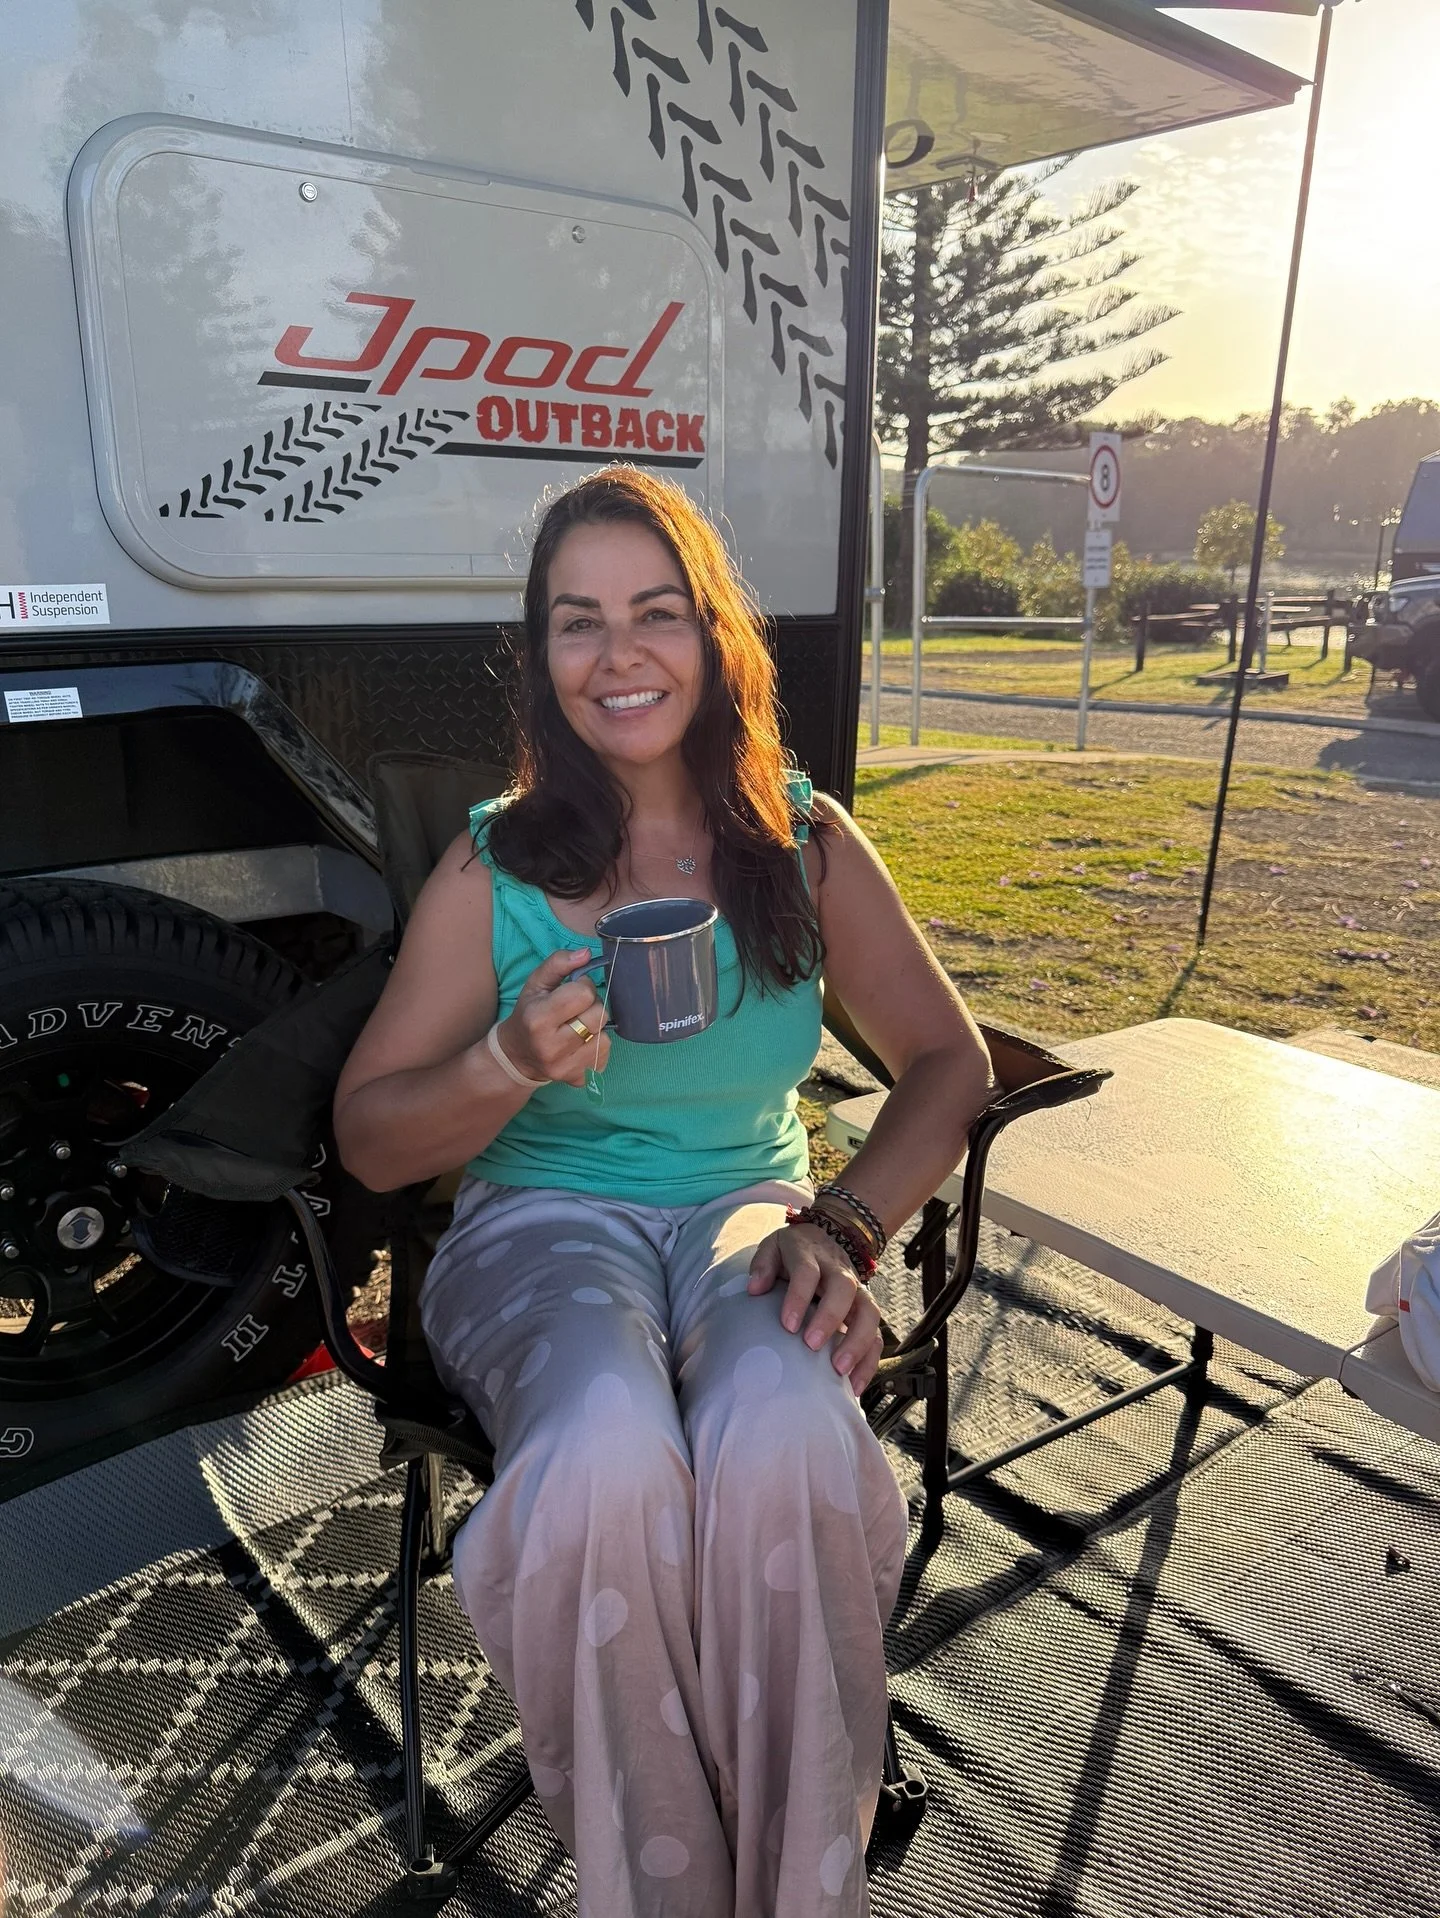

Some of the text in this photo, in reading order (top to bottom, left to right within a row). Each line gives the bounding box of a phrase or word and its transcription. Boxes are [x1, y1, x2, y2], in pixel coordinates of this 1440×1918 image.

[274, 291, 686, 399] Jpod
[476, 396, 706, 453] OUTBACK
[1100, 464, 1110, 492] 8
[30, 590, 104, 605] Independent
[32, 604, 98, 618] Suspension
[0, 1002, 241, 1049] DVEN
